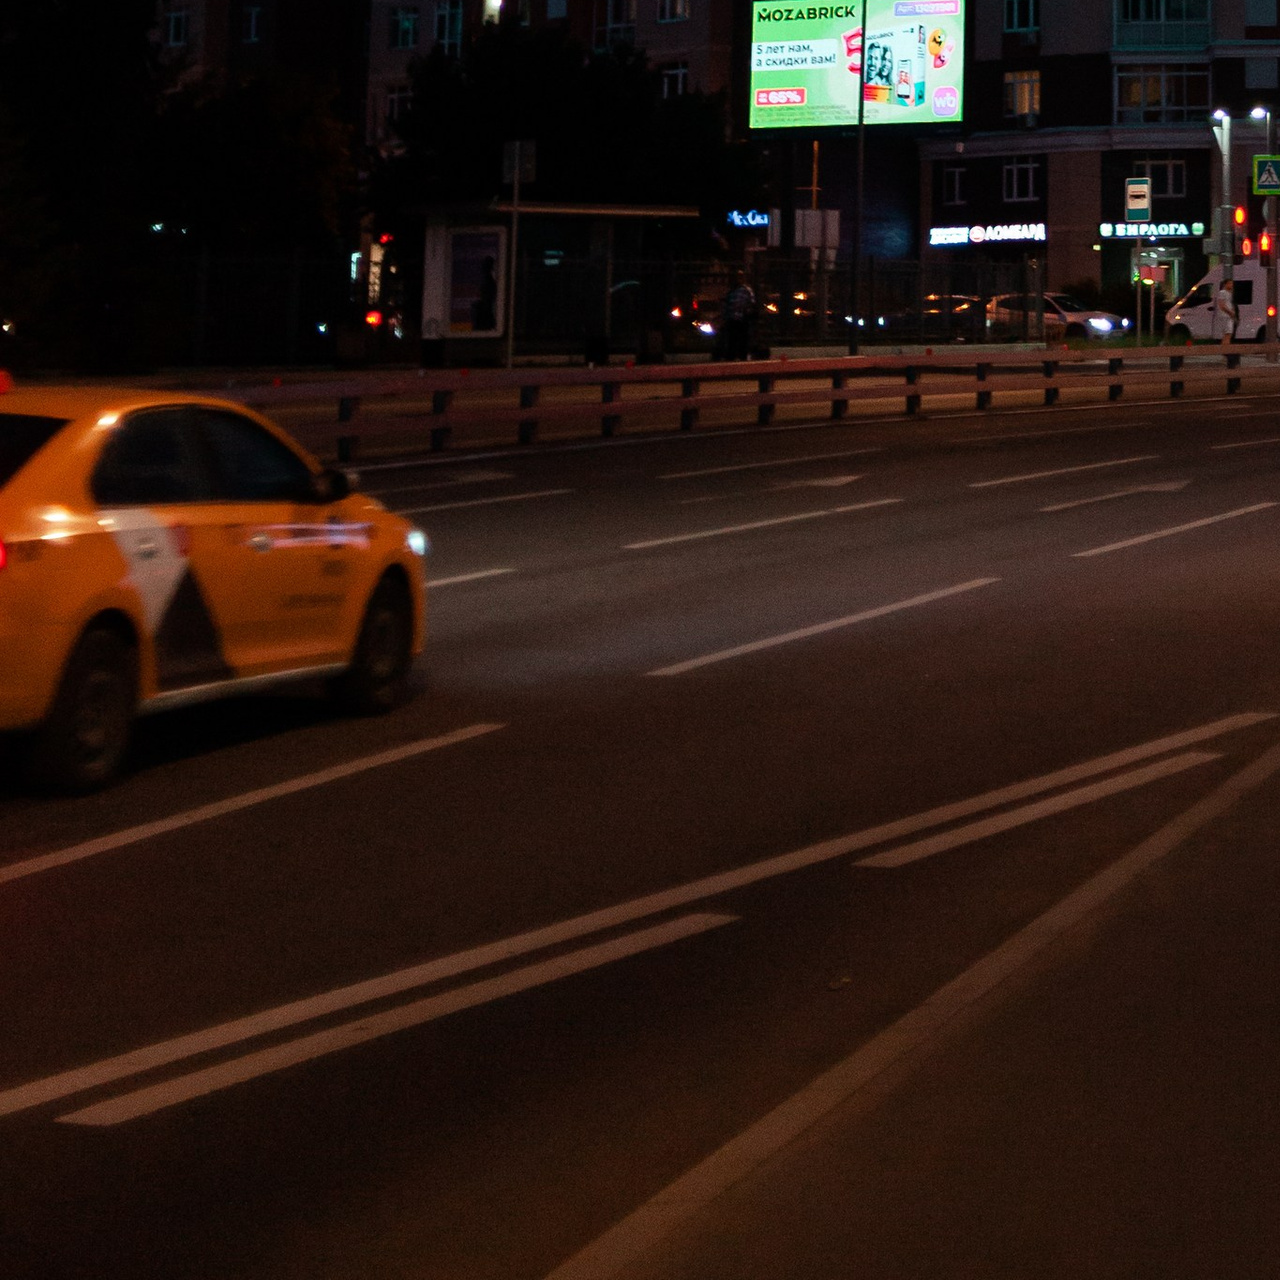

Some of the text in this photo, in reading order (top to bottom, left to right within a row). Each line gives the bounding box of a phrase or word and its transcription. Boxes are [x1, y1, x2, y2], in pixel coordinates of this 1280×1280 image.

[757, 5, 855, 22] MOZABRICK
[756, 44, 814, 55] 5 лет нам,
[756, 53, 836, 67] а скидки вам!
